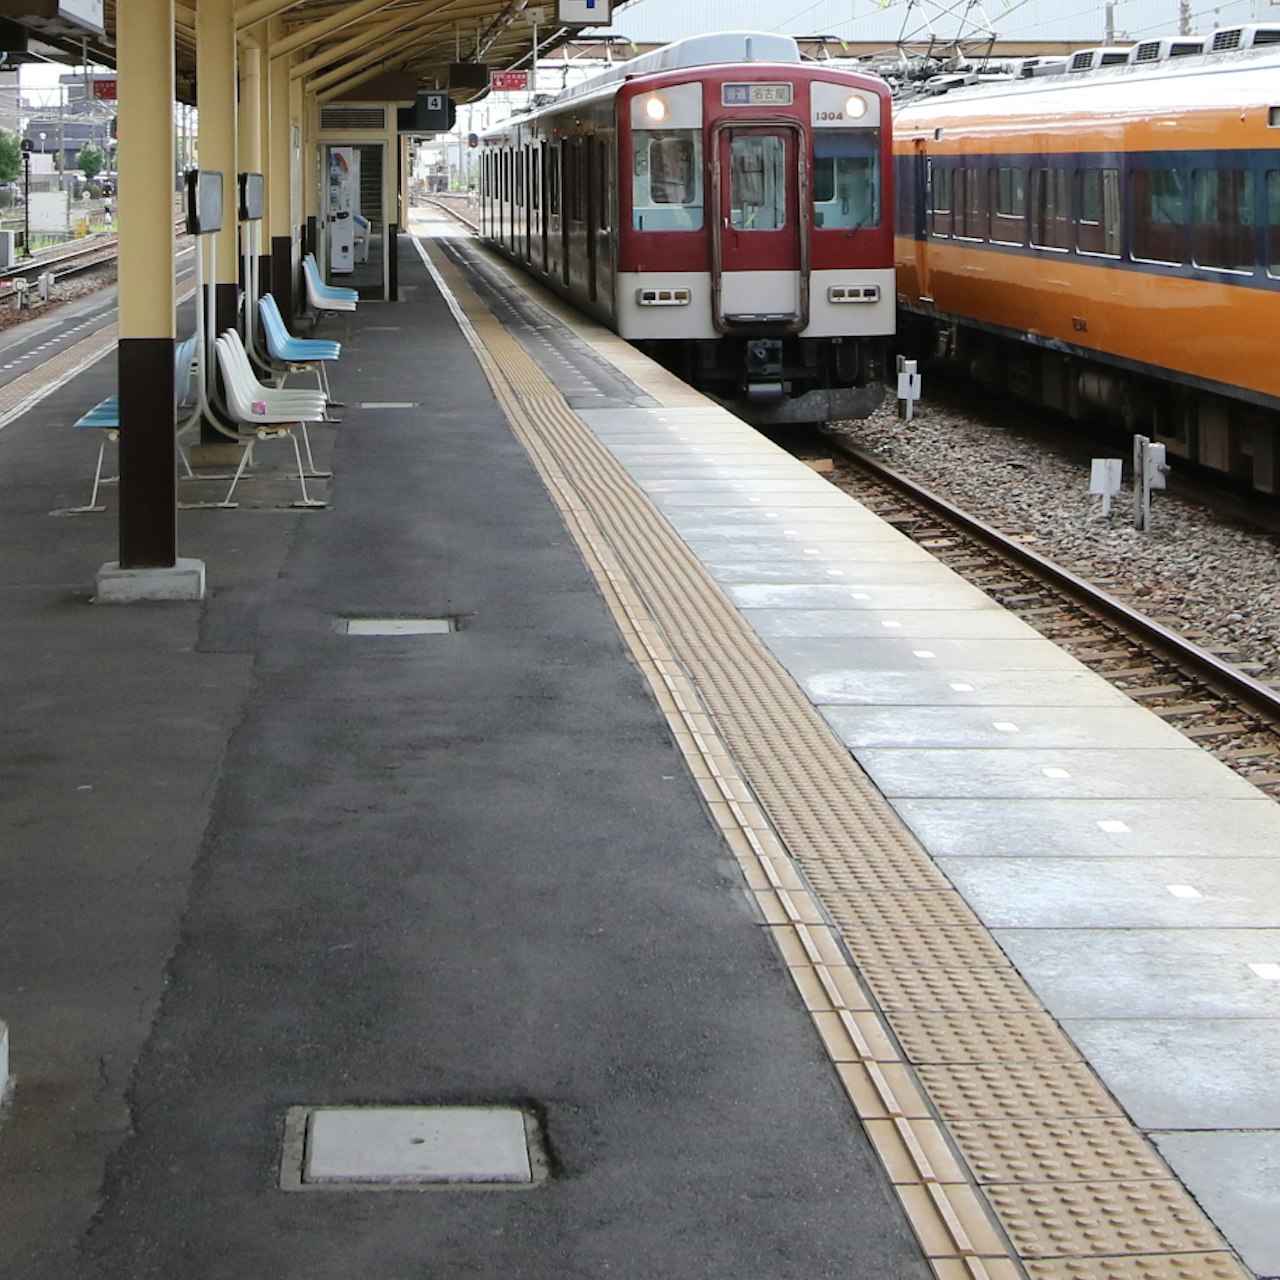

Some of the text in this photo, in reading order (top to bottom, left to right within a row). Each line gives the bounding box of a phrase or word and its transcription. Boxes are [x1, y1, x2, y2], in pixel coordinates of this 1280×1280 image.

[753, 87, 786, 101] 名古屋
[430, 97, 439, 109] 4
[816, 111, 844, 122] 1304
